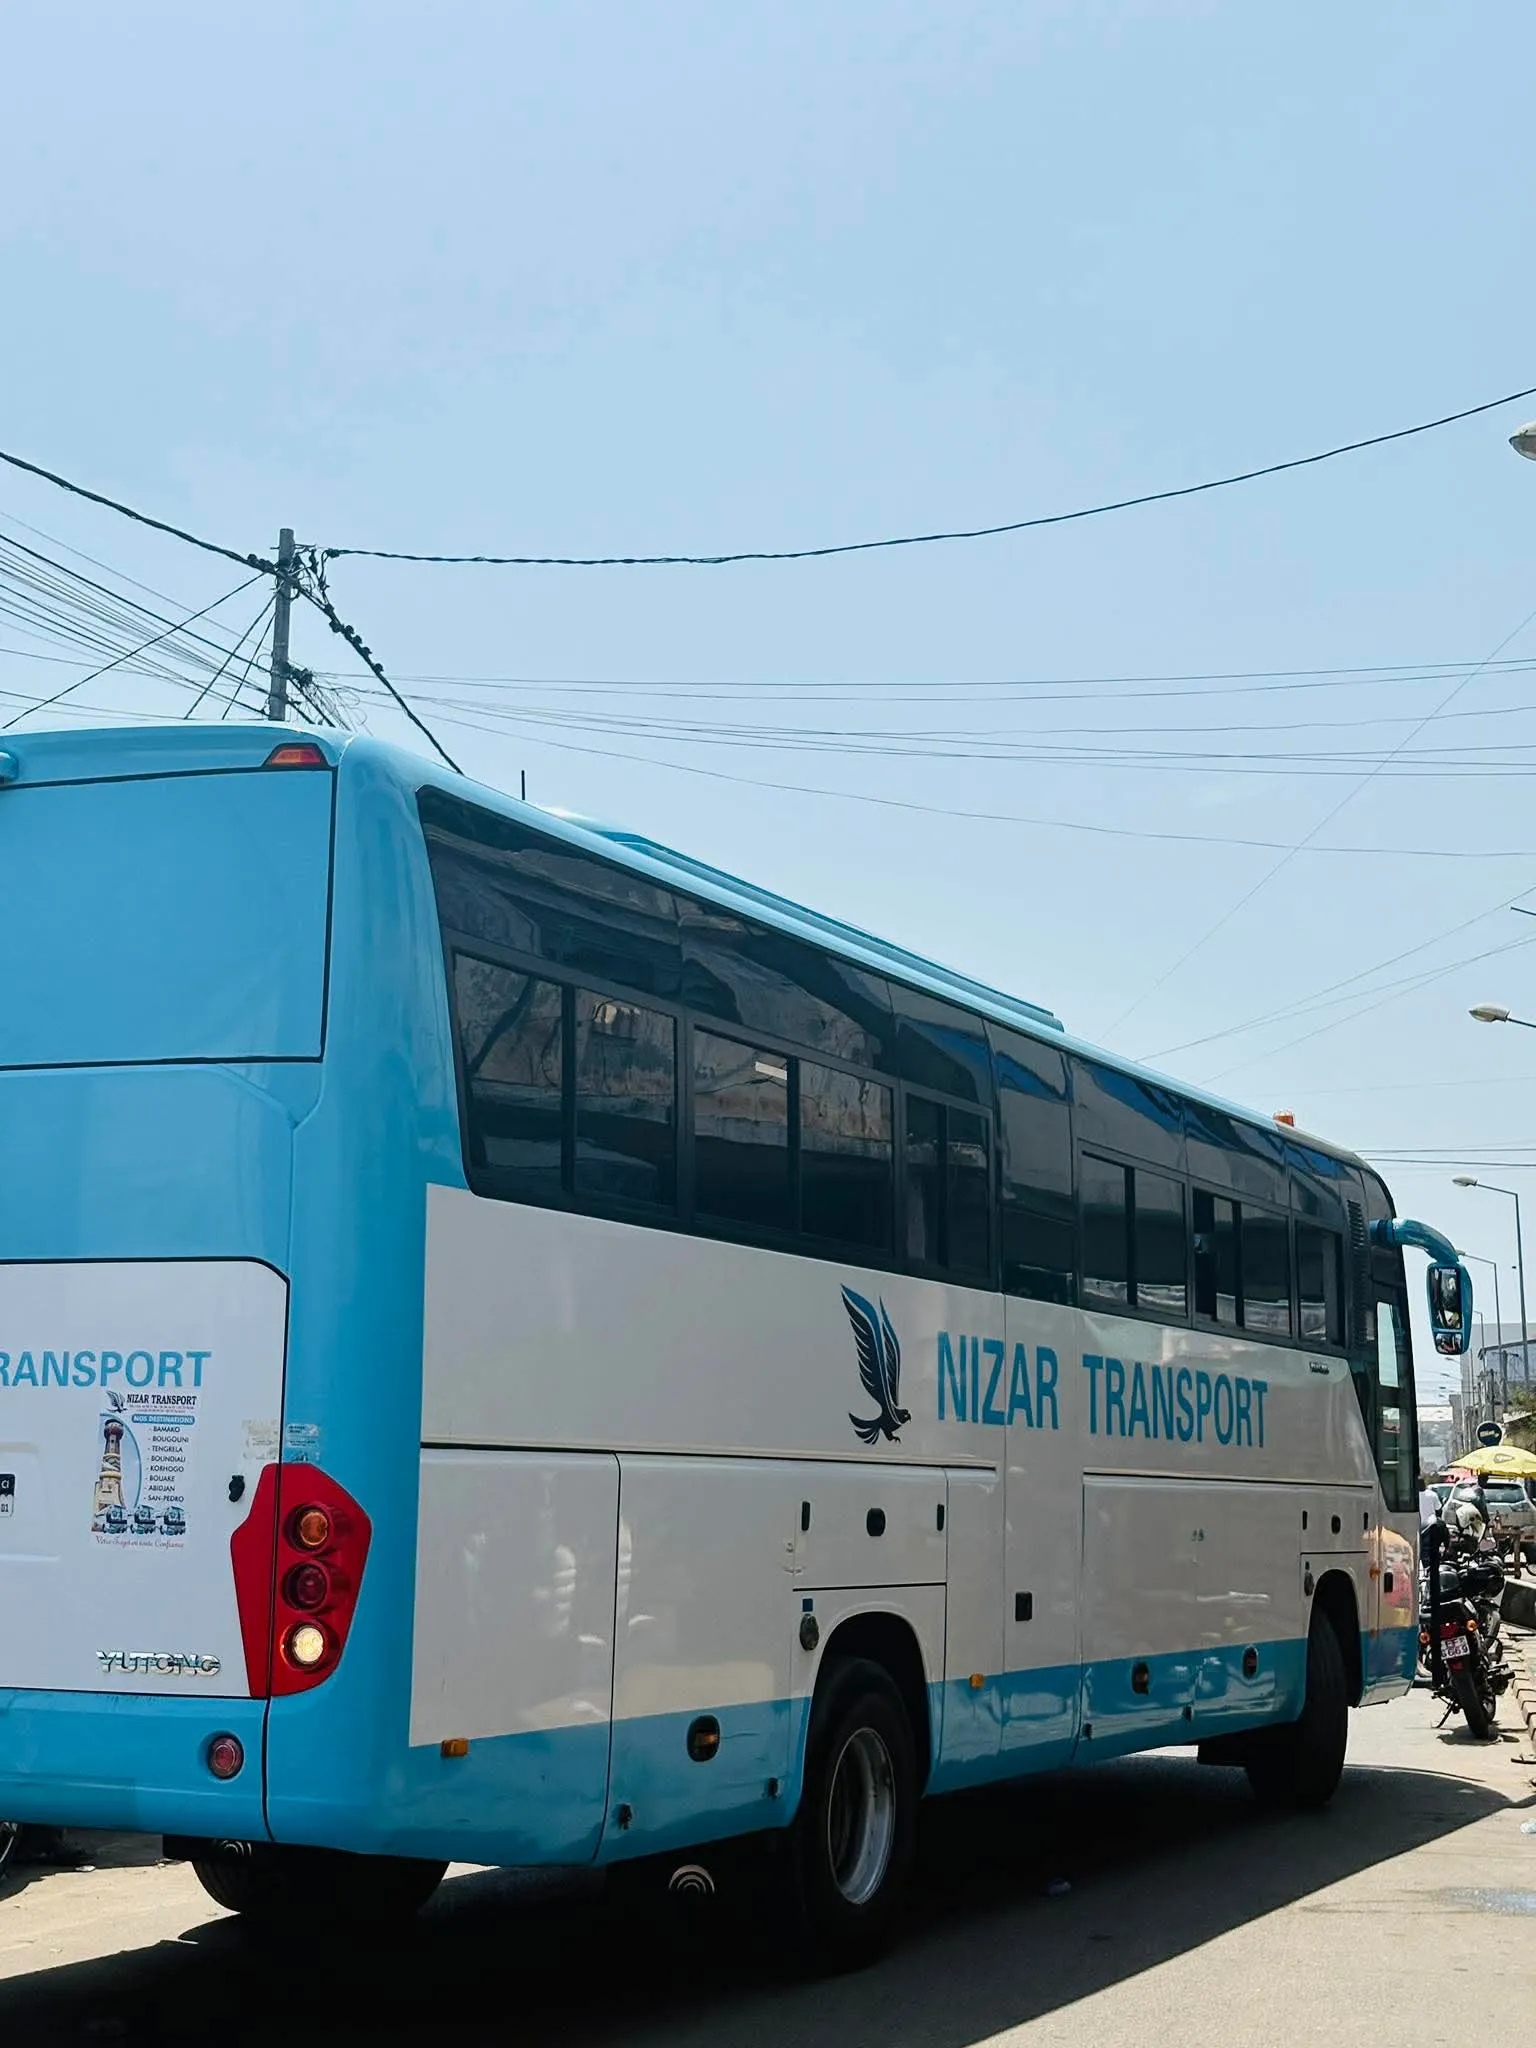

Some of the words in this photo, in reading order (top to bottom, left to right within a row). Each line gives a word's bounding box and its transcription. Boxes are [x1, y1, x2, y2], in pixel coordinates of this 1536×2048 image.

[937, 1331, 1059, 1430] NIZAR
[1082, 1354, 1268, 1448] TRANSPORT
[127, 1394, 149, 1404] NIZAR
[152, 1395, 197, 1405] TRANSPORT
[148, 1415, 193, 1424] DESTINATIONS
[148, 1495, 184, 1503] SAN-PEDRO
[96, 1651, 221, 1676] YUTONG
